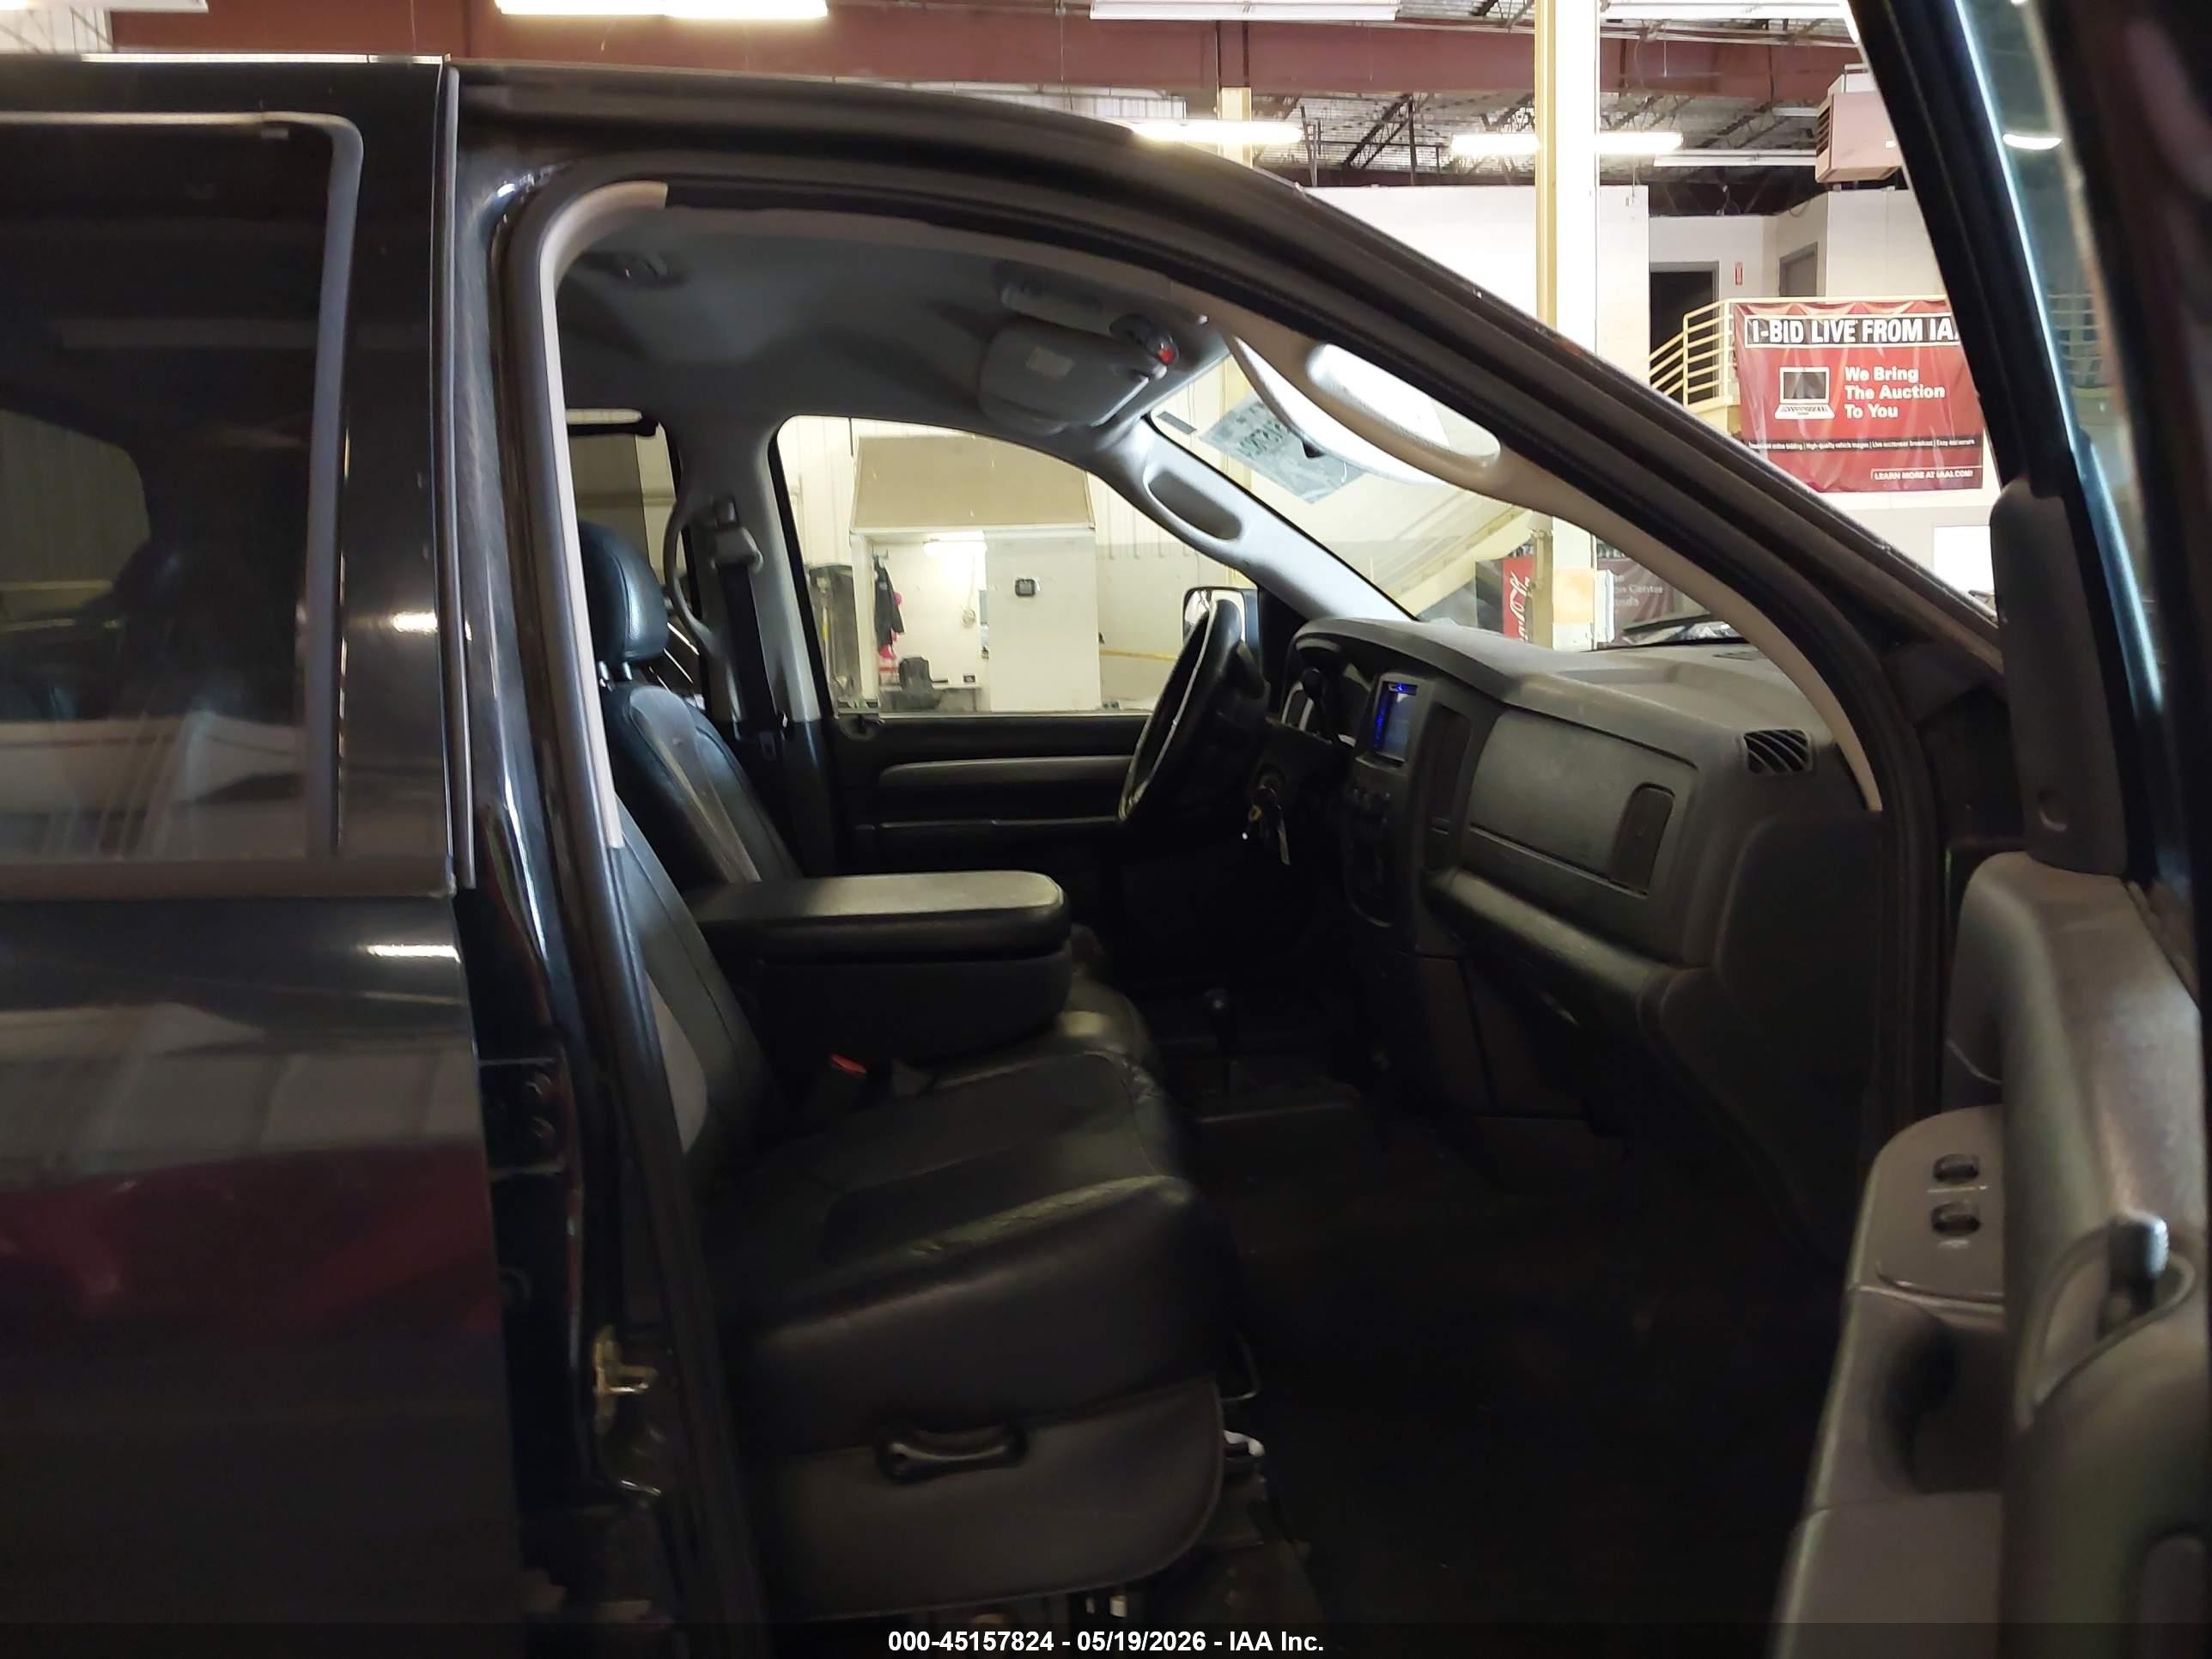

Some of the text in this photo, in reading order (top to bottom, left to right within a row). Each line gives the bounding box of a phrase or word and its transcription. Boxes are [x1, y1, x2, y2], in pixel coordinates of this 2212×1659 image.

[1752, 317, 1960, 343] I-BID LIVE FROM IA
[1844, 365, 1919, 384] We Bring
[1844, 384, 1946, 400] The Auction
[1844, 403, 1899, 419] To You
[1874, 471, 1901, 480] LEARN
[1901, 471, 1925, 479] MORE
